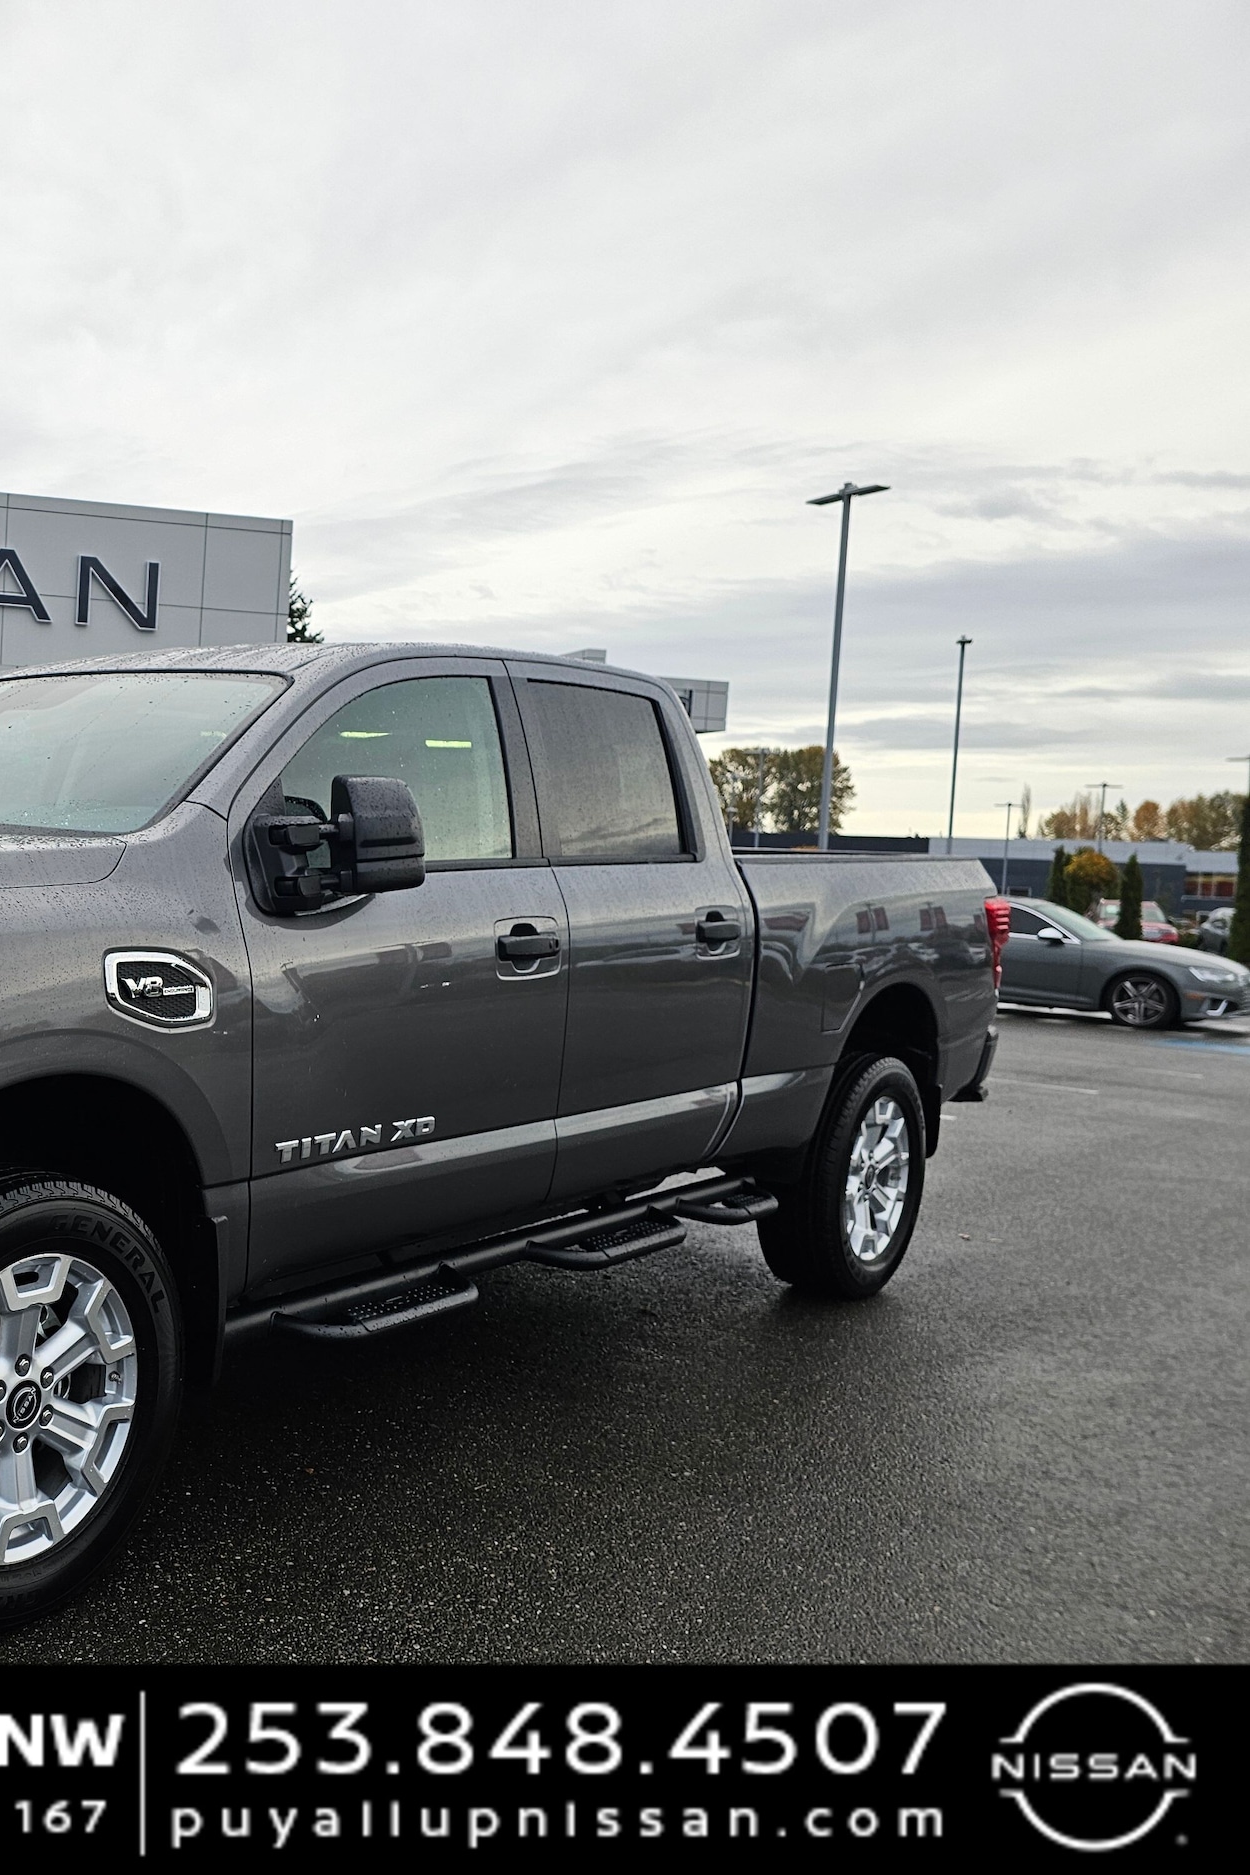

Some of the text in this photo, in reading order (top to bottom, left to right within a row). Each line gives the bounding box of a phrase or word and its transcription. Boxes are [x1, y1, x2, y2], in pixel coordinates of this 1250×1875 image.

[121, 976, 163, 999] V8
[275, 1115, 435, 1164] TITAN XD
[51, 1213, 166, 1313] GENERAL
